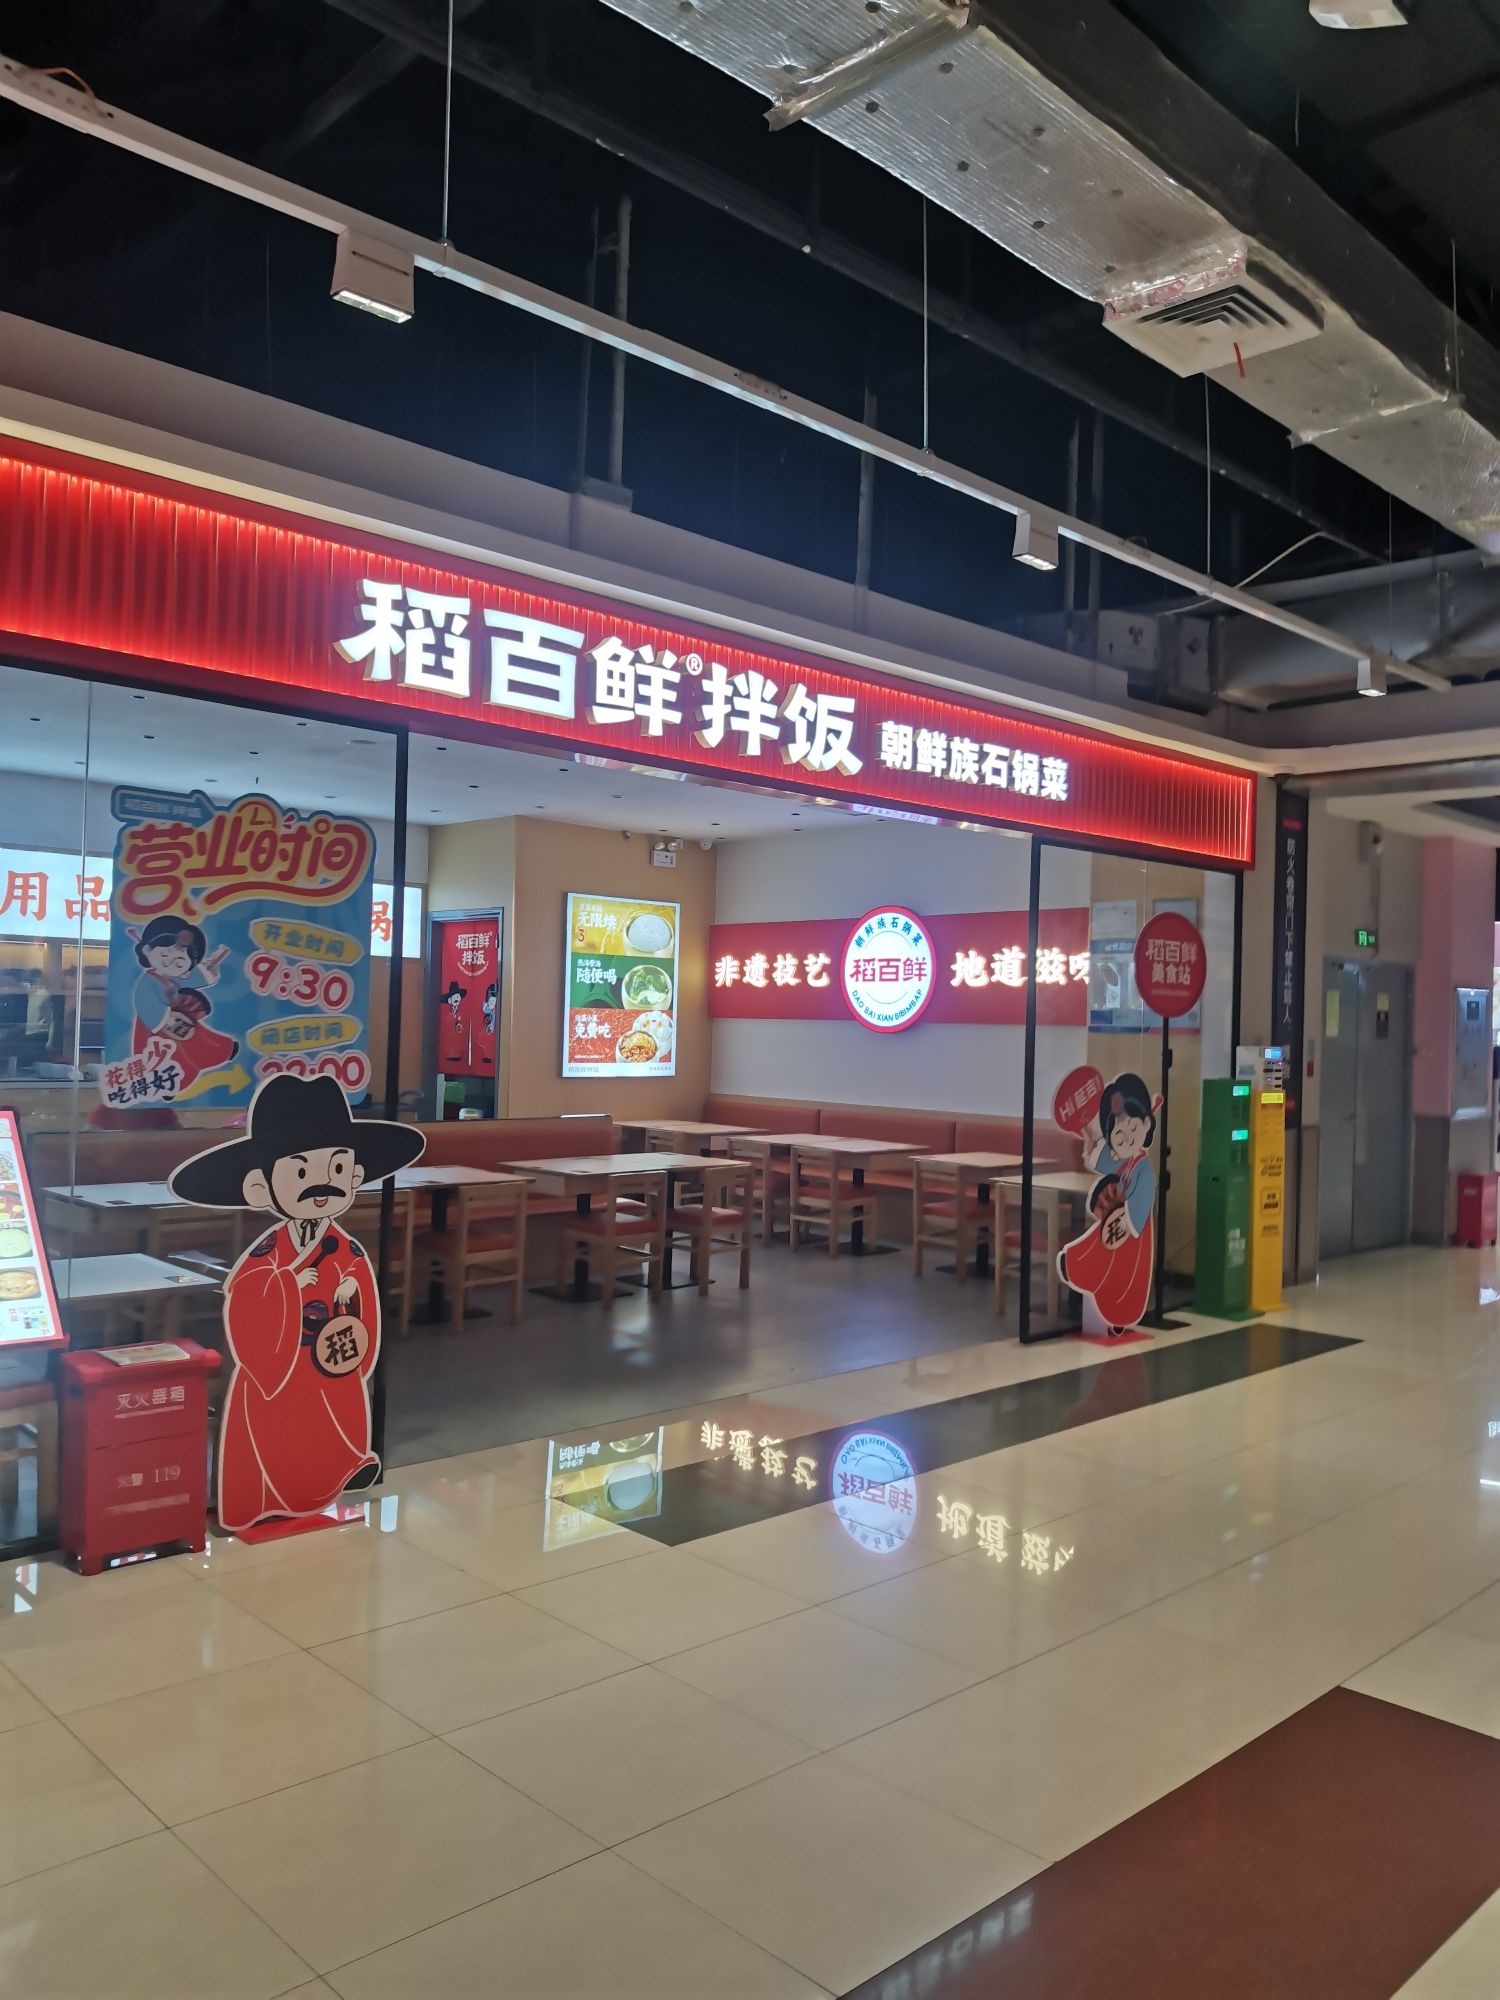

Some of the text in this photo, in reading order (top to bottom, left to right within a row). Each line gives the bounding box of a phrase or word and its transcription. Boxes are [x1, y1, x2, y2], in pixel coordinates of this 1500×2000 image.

[878, 721, 1069, 801] 朝鲜族石锅菜
[122, 814, 367, 915] 营业时间
[0, 870, 110, 921] 用品
[263, 922, 344, 958] 开业时间
[1145, 939, 1198, 963] 稻百鲜
[252, 955, 347, 1008] 9:30
[576, 967, 617, 985] 随便喝
[714, 952, 832, 988] 非遗技艺
[849, 957, 927, 982] 稻百鲜
[852, 989, 923, 1021] DAO BAI XIAN BIBIMBAP
[573, 1021, 612, 1039] 免费吃
[106, 1040, 172, 1088] 花得少
[107, 1064, 181, 1104] 吃得好
[325, 1324, 359, 1366] 稻
[116, 1385, 185, 1410] 灭火器箱
[153, 1464, 181, 1484] 119
